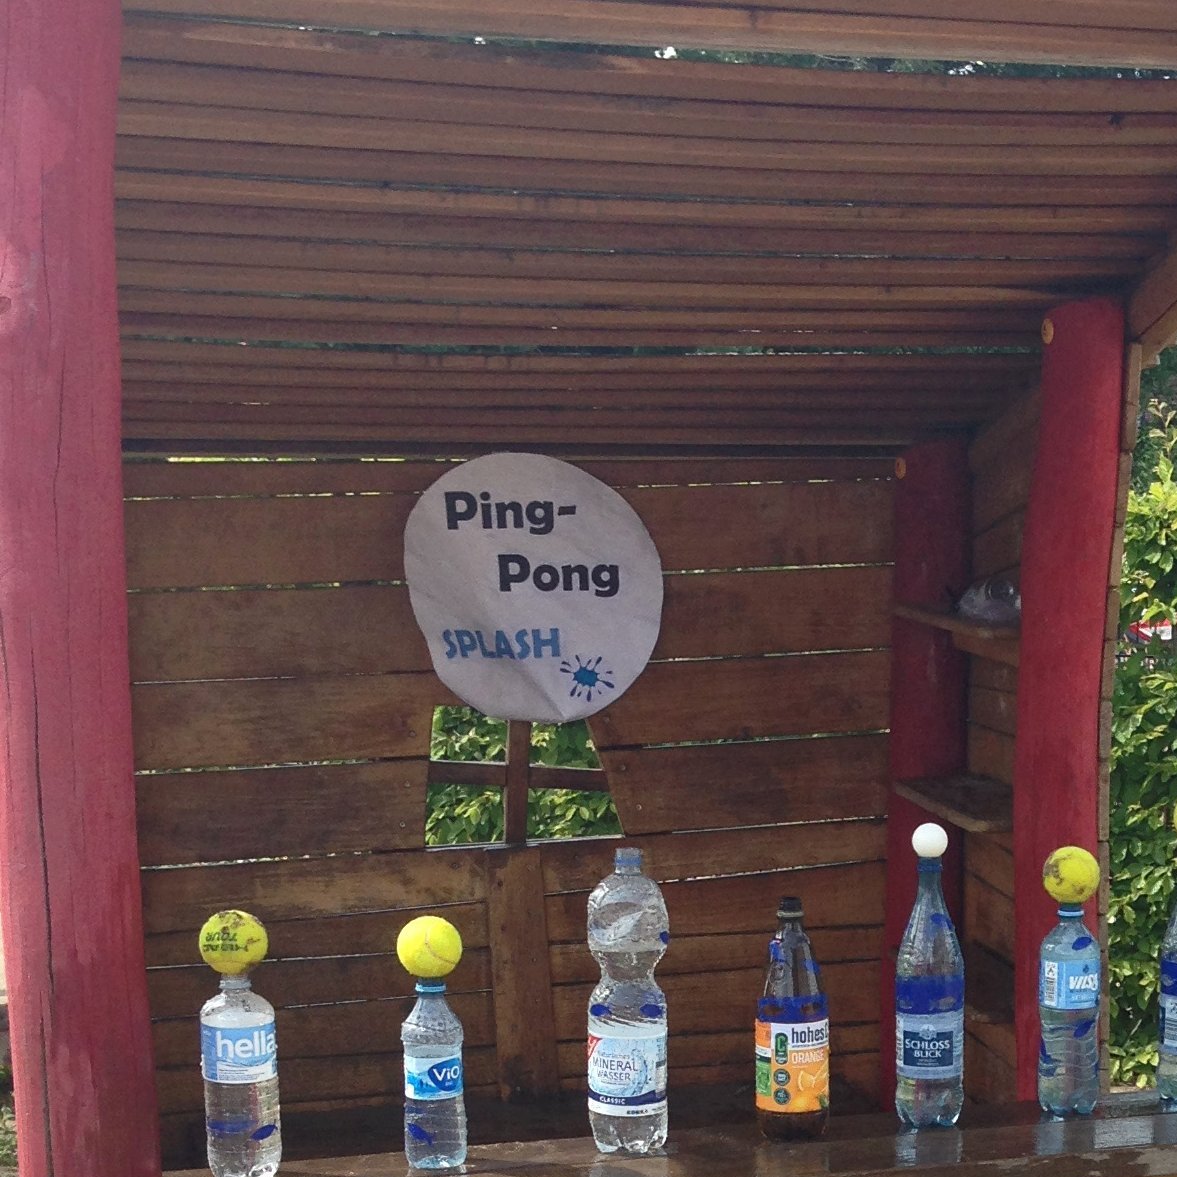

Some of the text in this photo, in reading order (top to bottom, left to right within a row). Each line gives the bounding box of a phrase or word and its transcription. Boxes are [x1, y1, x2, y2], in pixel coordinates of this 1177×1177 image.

[444, 491, 577, 535] Ping-
[497, 553, 620, 598] Pong
[442, 628, 561, 659] SPLASH
[791, 1026, 824, 1043] hohes
[215, 1030, 275, 1058] hella
[905, 1038, 950, 1050] SCHLOSS
[914, 1050, 942, 1058] BLICK
[592, 1056, 639, 1072] MINERAL
[599, 1096, 626, 1105] CLASSIC
